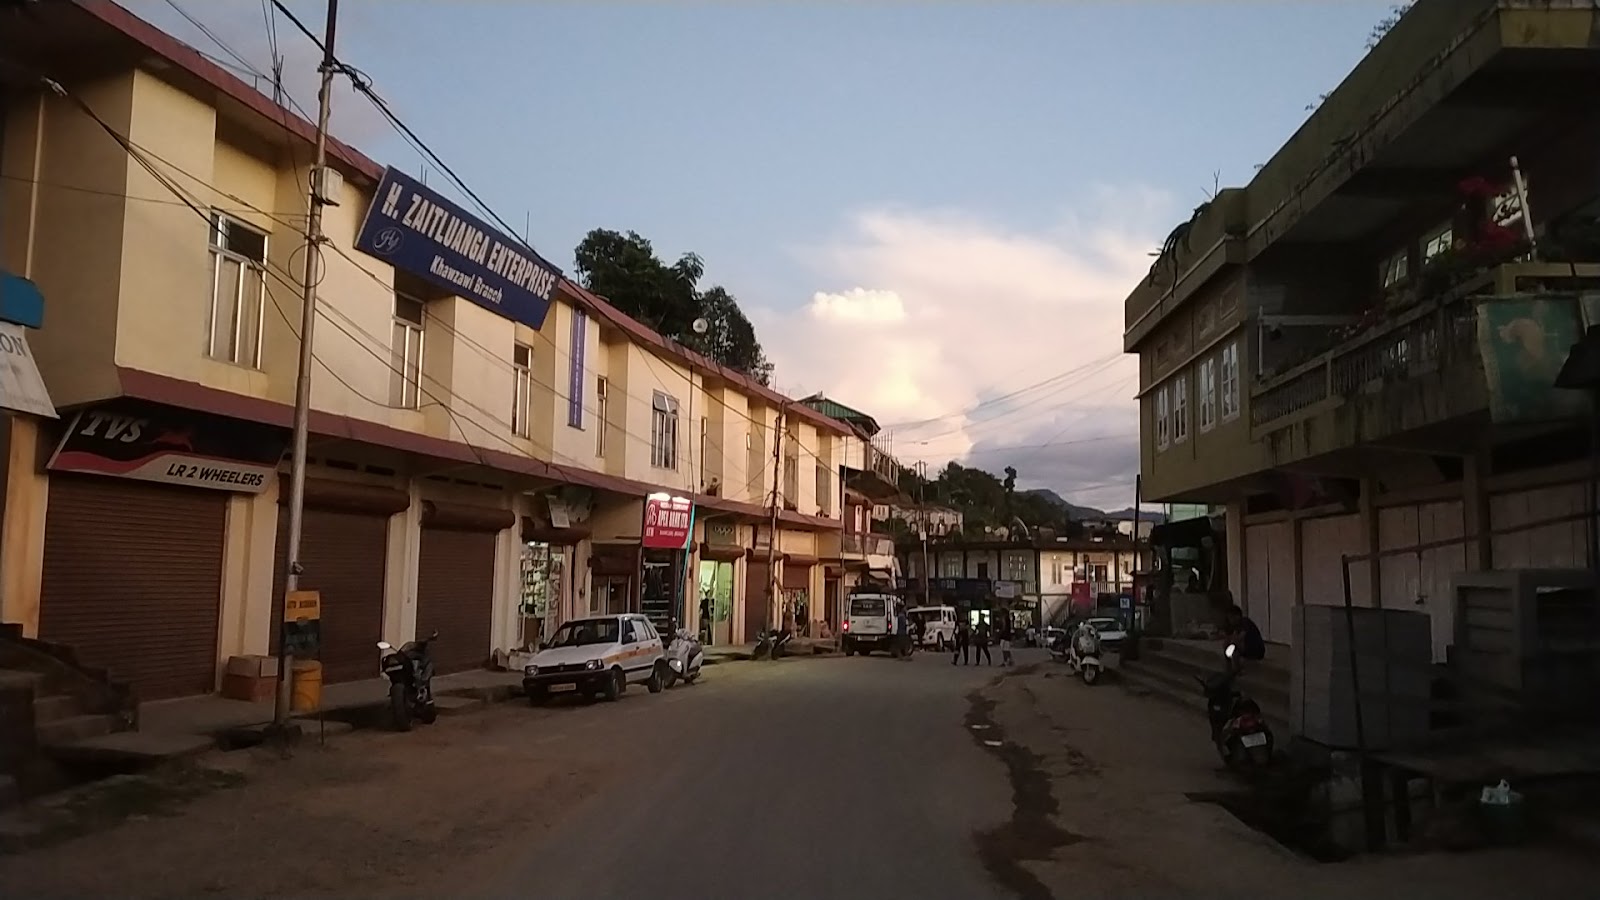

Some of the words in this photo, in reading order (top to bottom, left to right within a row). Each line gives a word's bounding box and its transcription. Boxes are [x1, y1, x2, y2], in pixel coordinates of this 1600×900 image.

[381, 181, 403, 220] H.
[401, 193, 490, 265] ZAITLUANGA
[486, 240, 555, 301] ENTERPRISE
[473, 274, 503, 305] Branch
[0, 331, 27, 357] ON
[80, 413, 146, 444] TVS
[167, 463, 186, 477] LR
[187, 466, 197, 478] 2
[199, 467, 264, 486] WHEELERS
